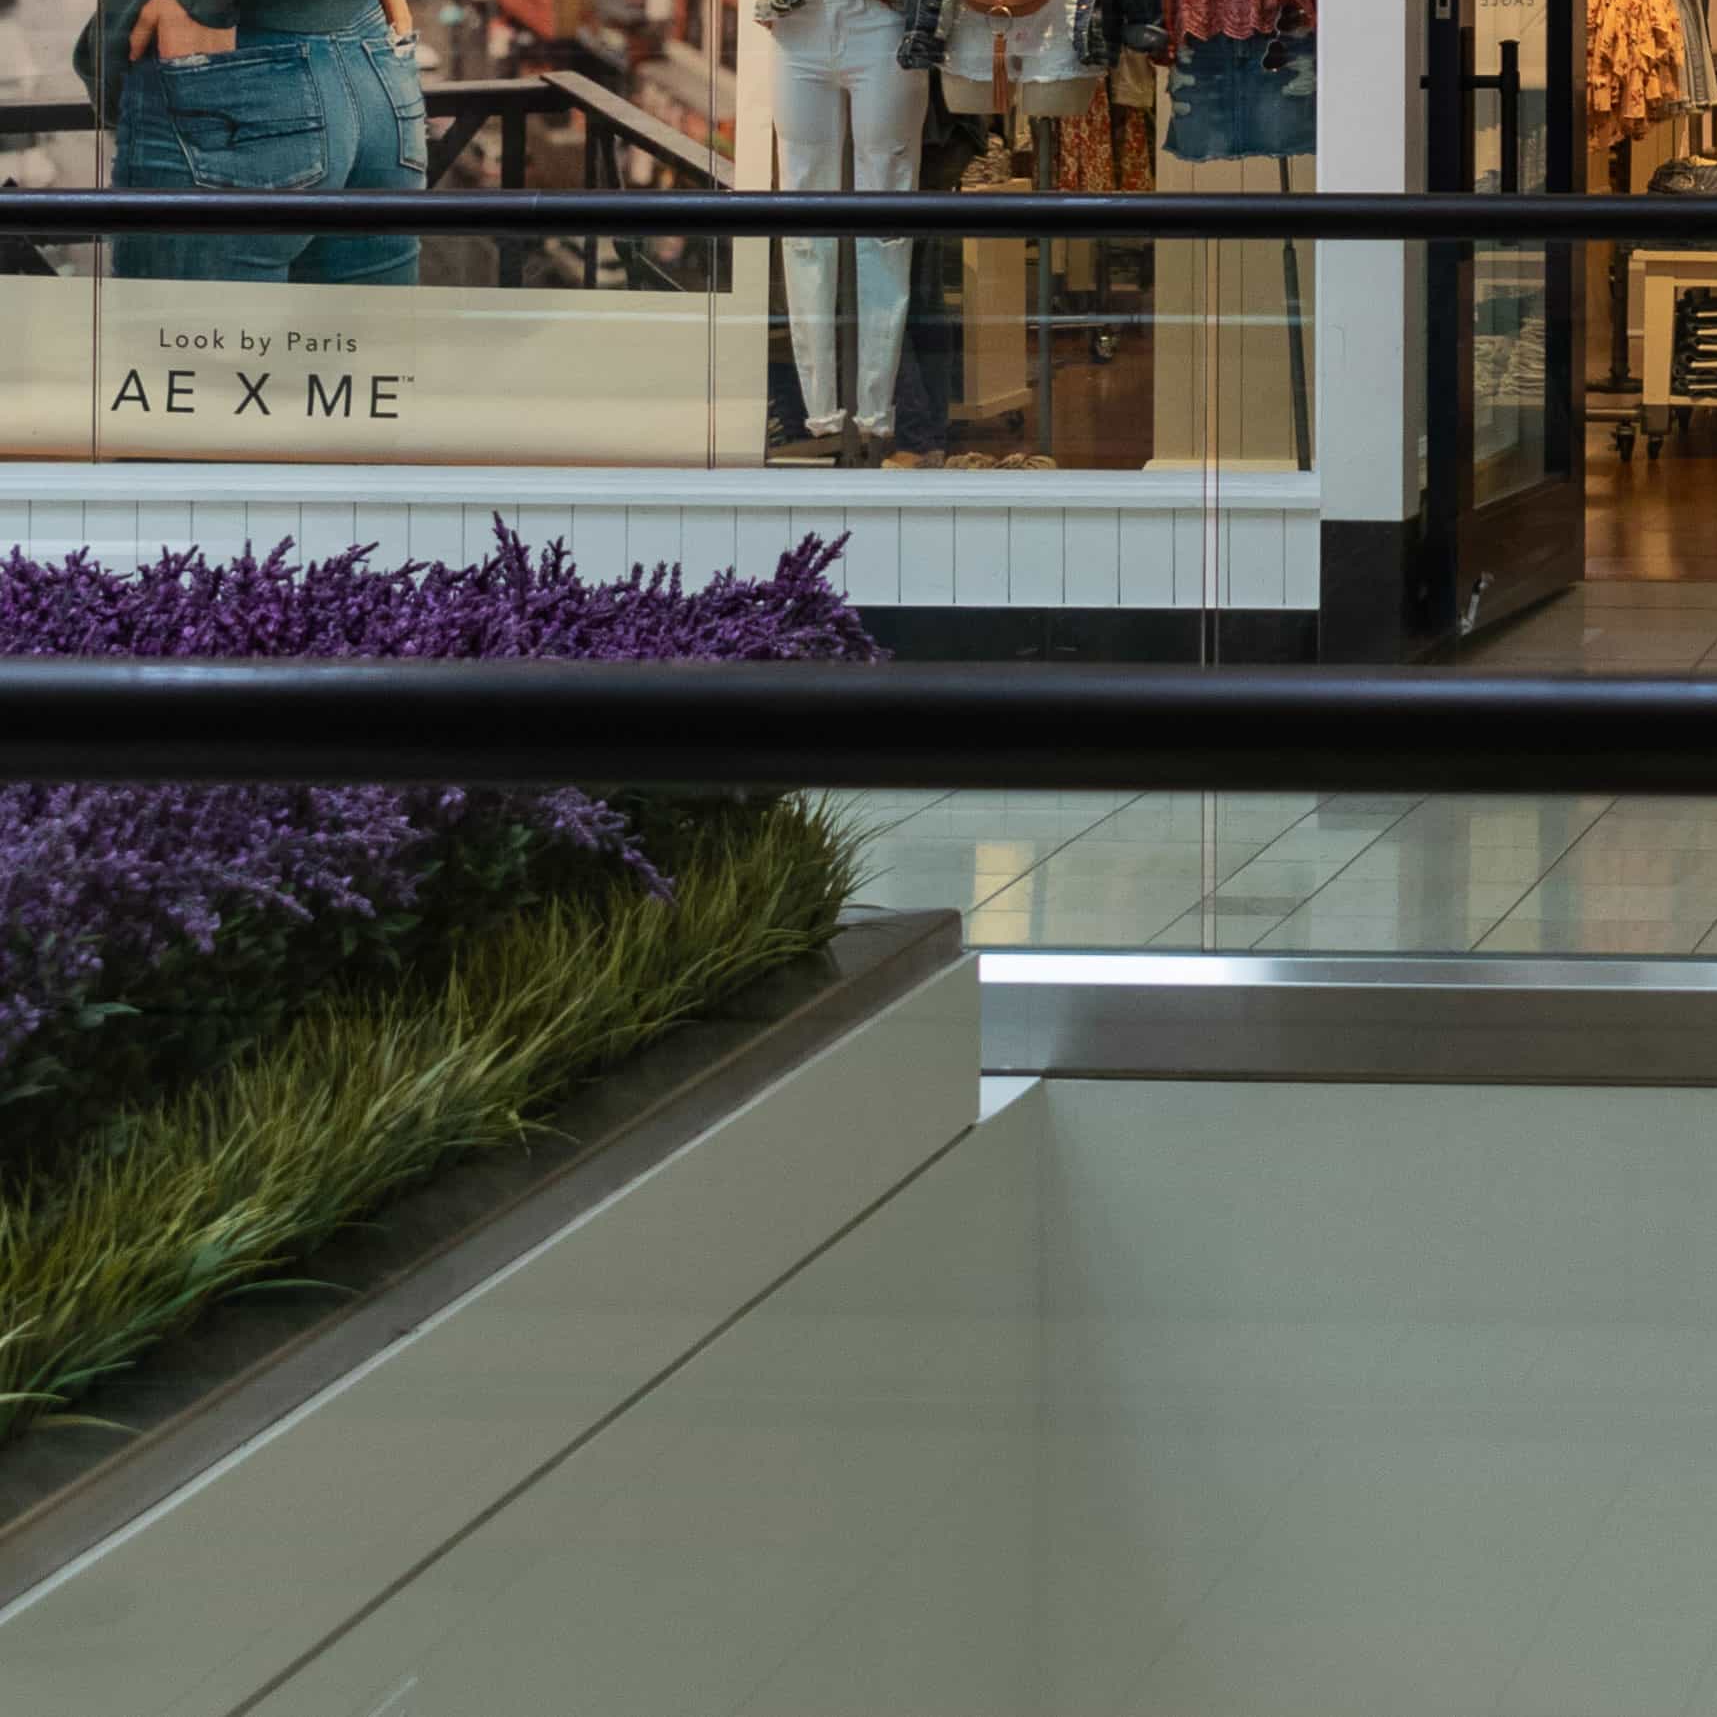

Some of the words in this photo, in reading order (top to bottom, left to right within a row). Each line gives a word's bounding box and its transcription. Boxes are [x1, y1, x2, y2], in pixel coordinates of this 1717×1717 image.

[159, 328, 225, 349] Look
[241, 329, 272, 356] by
[287, 331, 358, 353] Paris
[111, 369, 196, 413] AE
[234, 372, 271, 415] X
